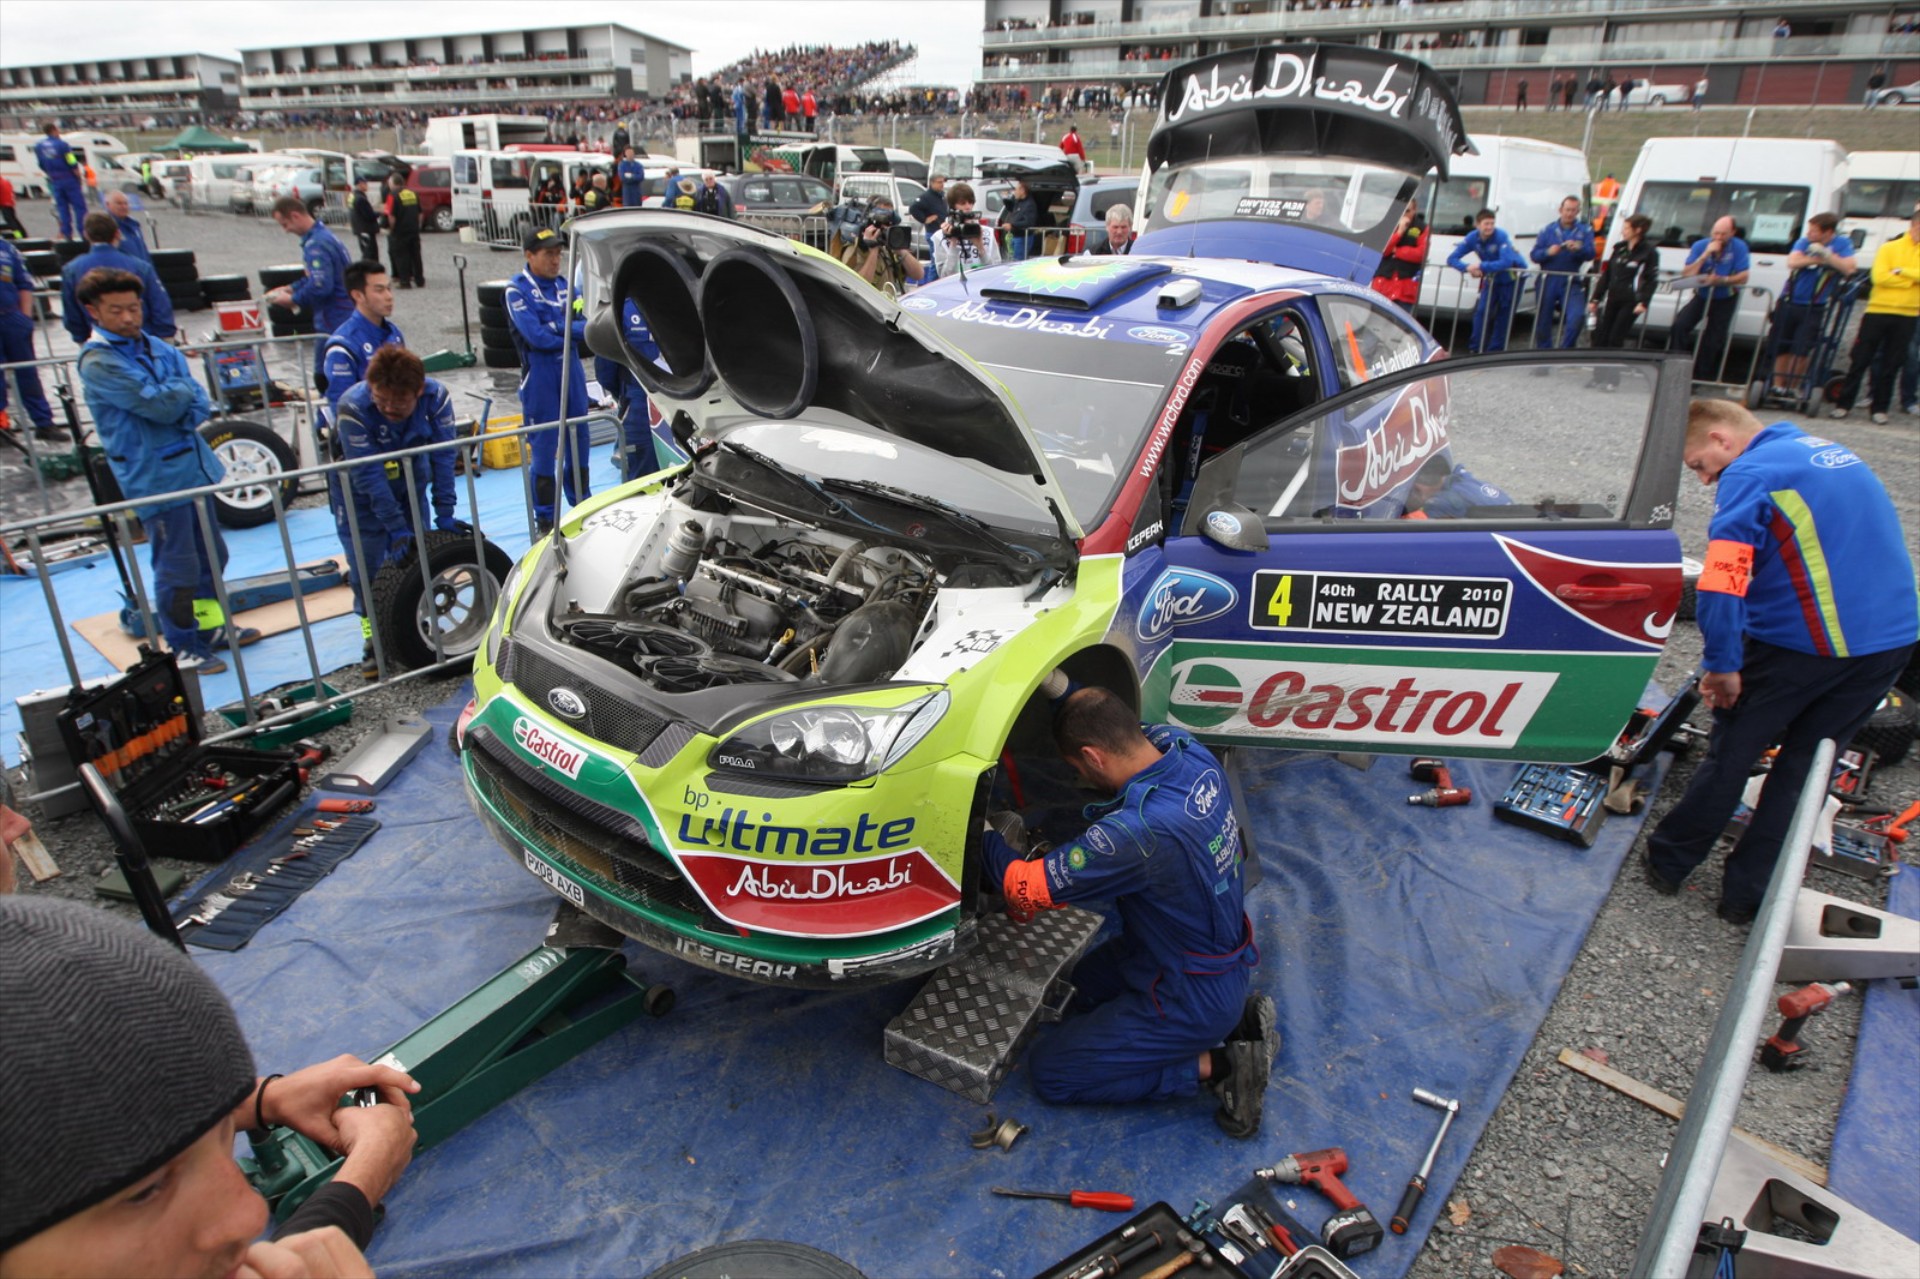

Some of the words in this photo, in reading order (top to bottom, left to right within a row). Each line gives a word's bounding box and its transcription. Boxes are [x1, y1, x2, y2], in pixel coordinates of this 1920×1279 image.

[1169, 63, 1264, 122] Abu
[1262, 53, 1413, 118] Dhabi
[1240, 199, 1282, 209] ZEALAND
[1255, 208, 1281, 217] RALLY
[1281, 201, 1305, 211] NEW
[936, 298, 1003, 327] Abu
[1000, 307, 1114, 340] Dhabi
[1137, 328, 1178, 341] Ford
[1165, 343, 1187, 355] 2
[1140, 358, 1205, 477] www.wrcford.com
[1341, 417, 1412, 501] Abu
[1127, 520, 1164, 551] ICEPEAK
[1267, 575, 1293, 627] 4
[1320, 584, 1356, 597] 40th
[1377, 583, 1445, 602] RALLY
[1462, 587, 1502, 601] 2010
[1316, 602, 1374, 624] NEW
[1379, 605, 1501, 628] ZEALAND
[1247, 671, 1524, 736] Castrol
[526, 728, 580, 774] Castrol
[719, 755, 756, 769] PIAA
[683, 784, 710, 811] bp
[678, 807, 916, 856] ultimate
[1208, 834, 1223, 855] BP
[527, 853, 554, 884] PX08
[557, 876, 582, 902] AXB
[726, 864, 812, 899] Abu
[808, 858, 913, 897] Dhabi
[1017, 880, 1034, 910] FORD
